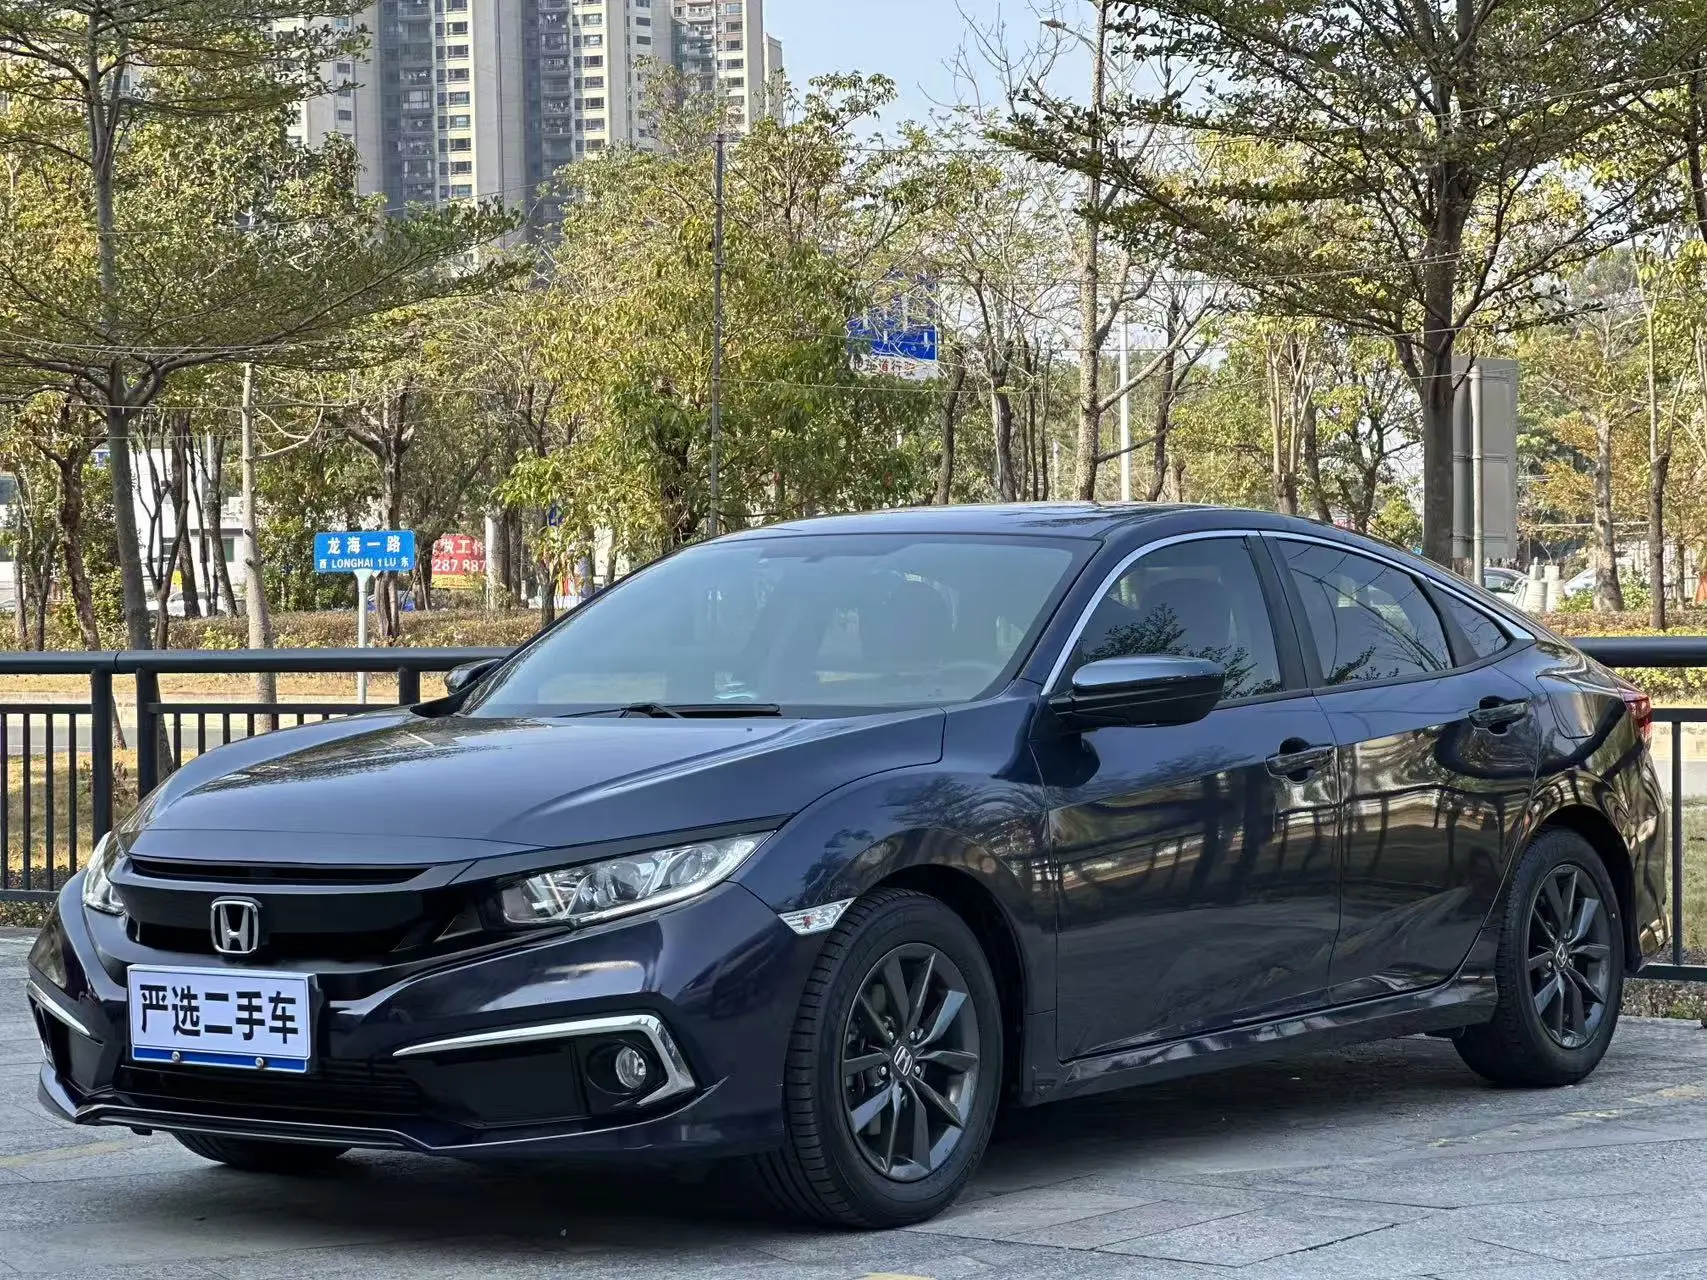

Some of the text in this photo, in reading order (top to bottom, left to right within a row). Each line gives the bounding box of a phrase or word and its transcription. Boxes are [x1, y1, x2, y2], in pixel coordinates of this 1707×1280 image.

[327, 535, 401, 554] 龙海一路
[319, 559, 327, 569] 西
[331, 557, 373, 569] LONGHAI
[400, 556, 409, 568] 东
[139, 983, 299, 1045] 严选二手车
